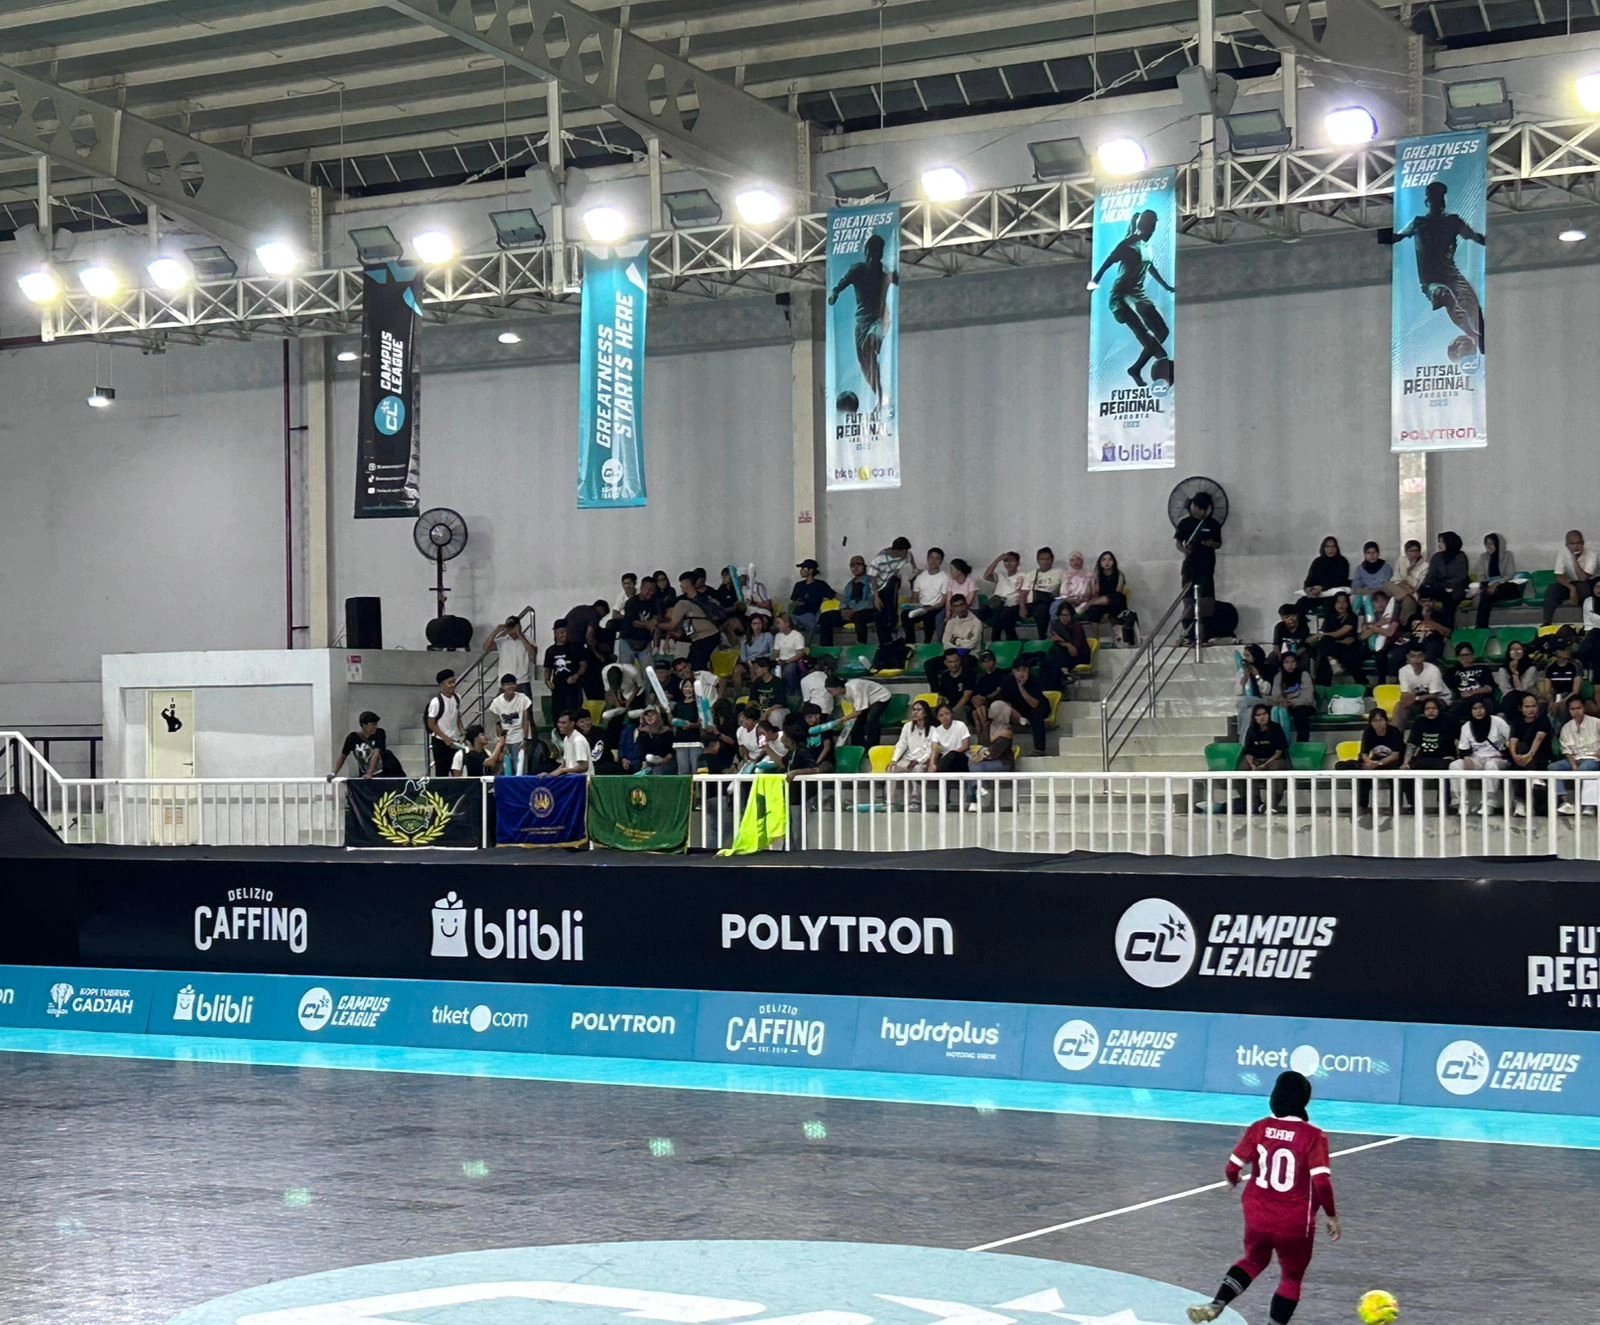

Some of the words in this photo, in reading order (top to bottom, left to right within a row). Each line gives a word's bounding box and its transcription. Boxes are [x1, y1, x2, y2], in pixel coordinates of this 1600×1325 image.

[1401, 139, 1480, 160] GREATNESS
[1401, 156, 1455, 174] STARTS
[832, 212, 894, 229] GREATNESS
[832, 226, 874, 243] STARTS
[832, 240, 860, 255] HERE
[615, 291, 633, 349] HERE
[380, 330, 393, 391] CAMPUS
[391, 338, 403, 395] LEAGUE
[1416, 365, 1461, 377] FUTSAL
[596, 325, 613, 449] GREATNESS
[613, 354, 633, 438] STARTS
[1111, 388, 1152, 400] FUTSAL
[1403, 376, 1474, 395] REGIONAL
[1099, 399, 1165, 417] REGIONAL
[1401, 428, 1477, 441] POLYTRON
[1118, 443, 1162, 461] blibli
[228, 887, 273, 902] DELIZIO
[474, 907, 584, 961] blibli
[721, 913, 954, 955] POLYTRON
[1208, 914, 1337, 947] CAMPUS
[1559, 925, 1600, 954] FU
[1124, 932, 1181, 963] CL
[1198, 947, 1318, 979] LEAGUE
[1528, 955, 1600, 995] REG
[72, 997, 134, 1014] GADJAH
[196, 993, 253, 1024] blibli
[337, 995, 391, 1012] CAMPUS
[759, 1003, 798, 1016] DELIZIO
[330, 1011, 380, 1028] LEAGUE
[570, 1012, 676, 1035] POLYTRON
[881, 1016, 999, 1049] hydroplus
[1105, 1029, 1178, 1050] CAMPUS
[1098, 1048, 1165, 1068] LEAGUE
[1497, 1051, 1581, 1073] CAMPUS
[1489, 1071, 1567, 1092] LEAGUE
[1255, 1143, 1296, 1192] 10
